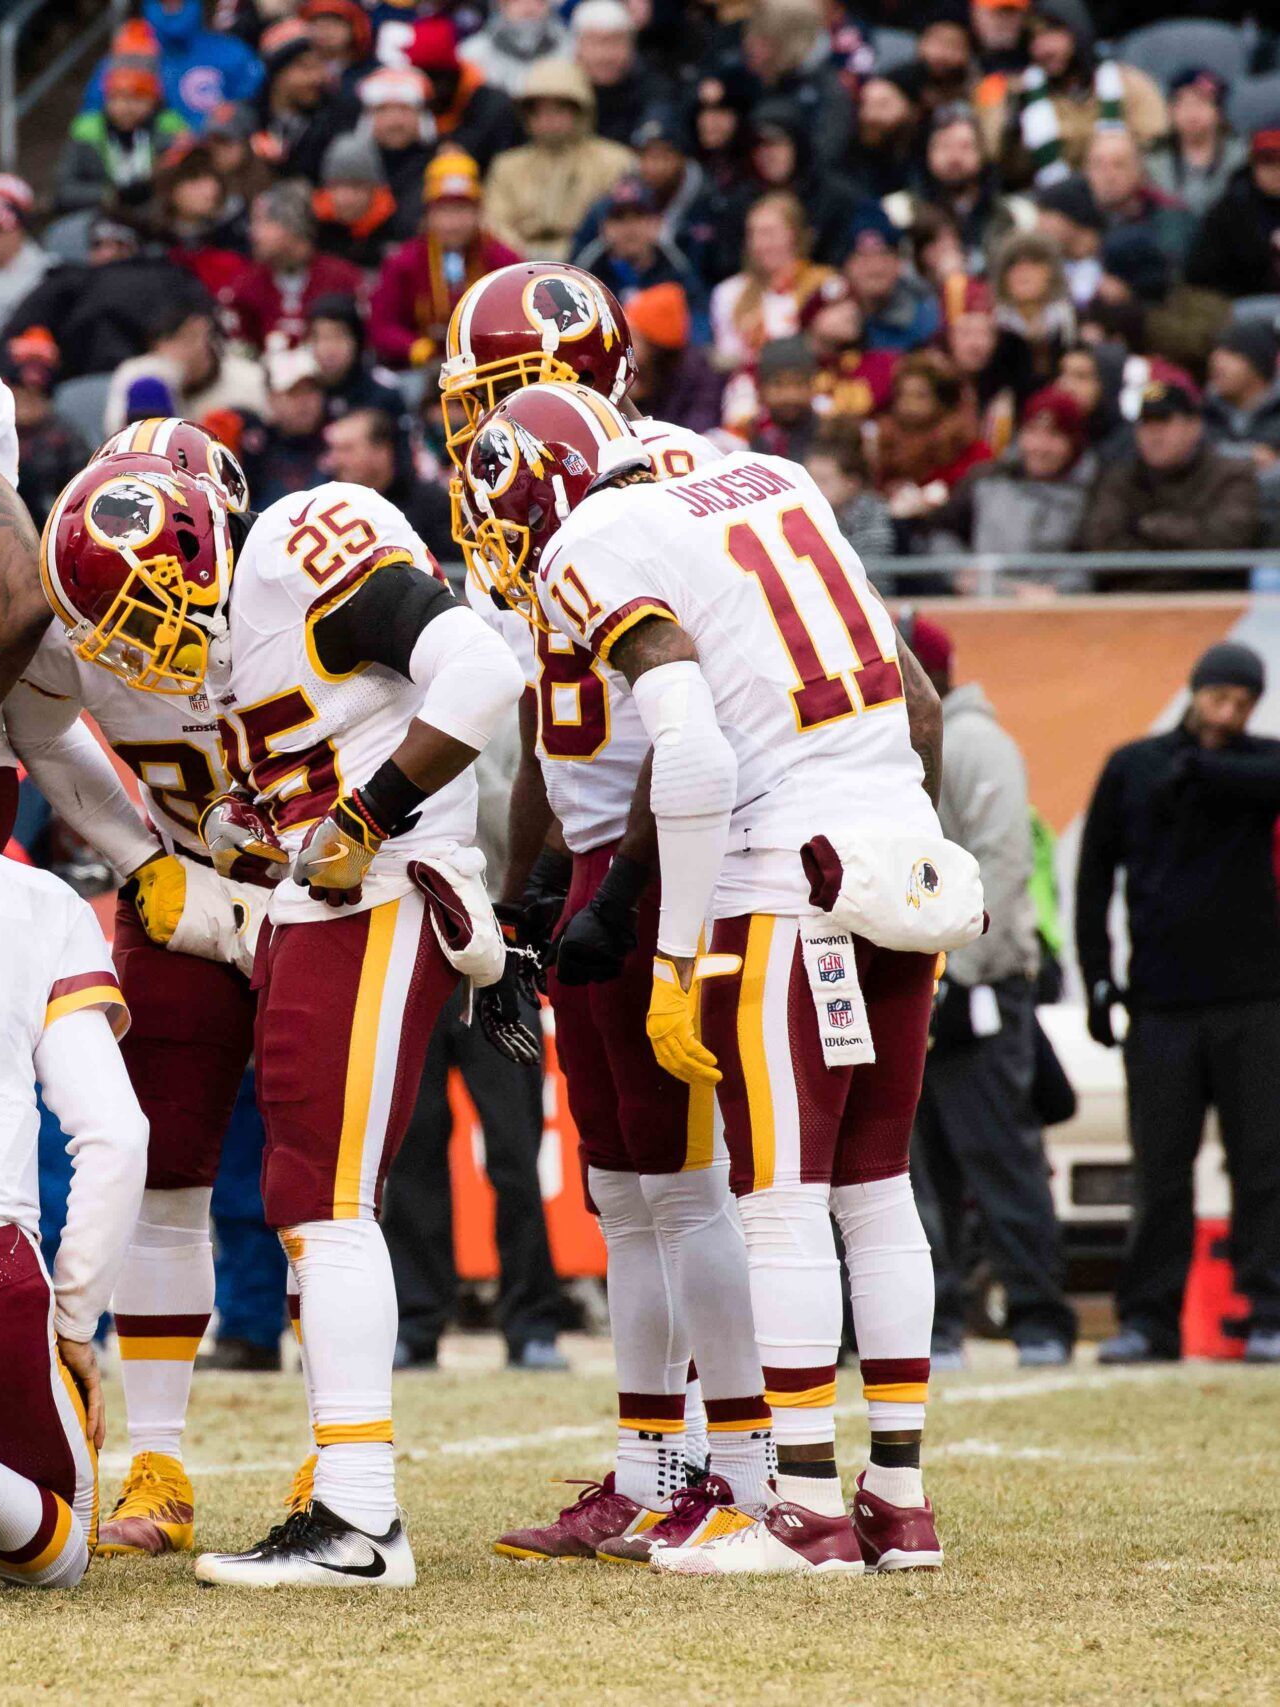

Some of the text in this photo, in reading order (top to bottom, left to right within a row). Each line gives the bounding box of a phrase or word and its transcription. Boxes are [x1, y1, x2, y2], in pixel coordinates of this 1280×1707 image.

[665, 462, 796, 518] JACKSON
[286, 500, 378, 589] 25
[548, 563, 605, 641] 11
[725, 503, 906, 734] 11
[181, 724, 219, 733] REDSK
[517, 618, 612, 762] 8
[824, 1036, 863, 1047] Wilson
